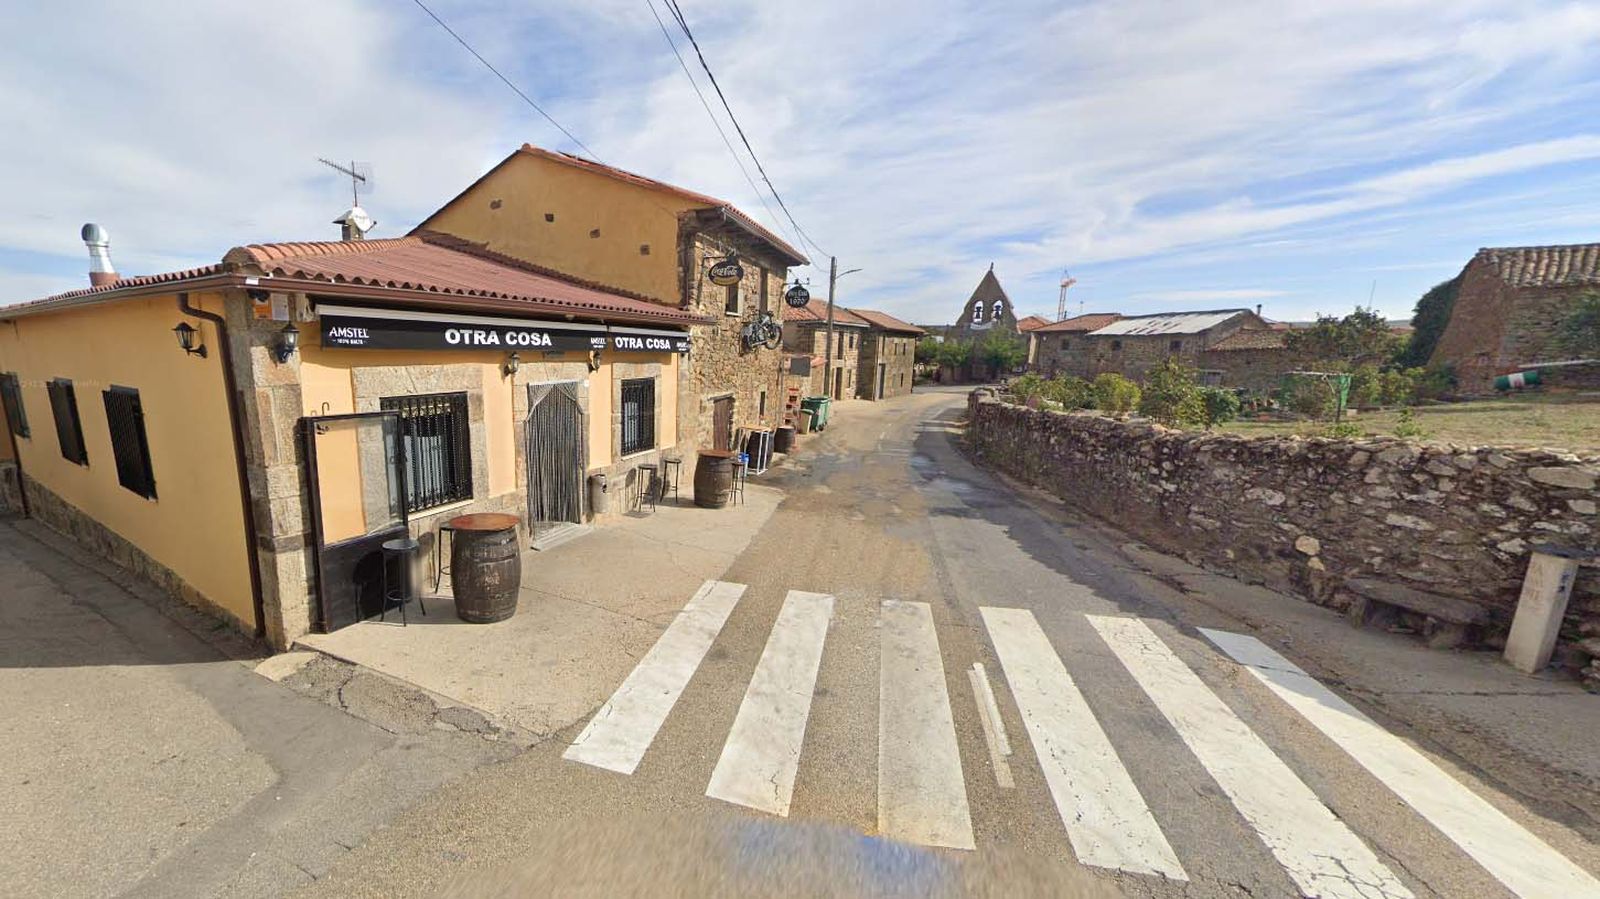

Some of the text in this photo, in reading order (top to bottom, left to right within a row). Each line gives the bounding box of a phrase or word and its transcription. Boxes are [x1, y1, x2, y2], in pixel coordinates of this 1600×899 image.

[329, 326, 369, 338] AMSTEL
[444, 328, 552, 346] OTRA COSA
[615, 337, 643, 349] OTRA
[646, 338, 671, 350] COSA
